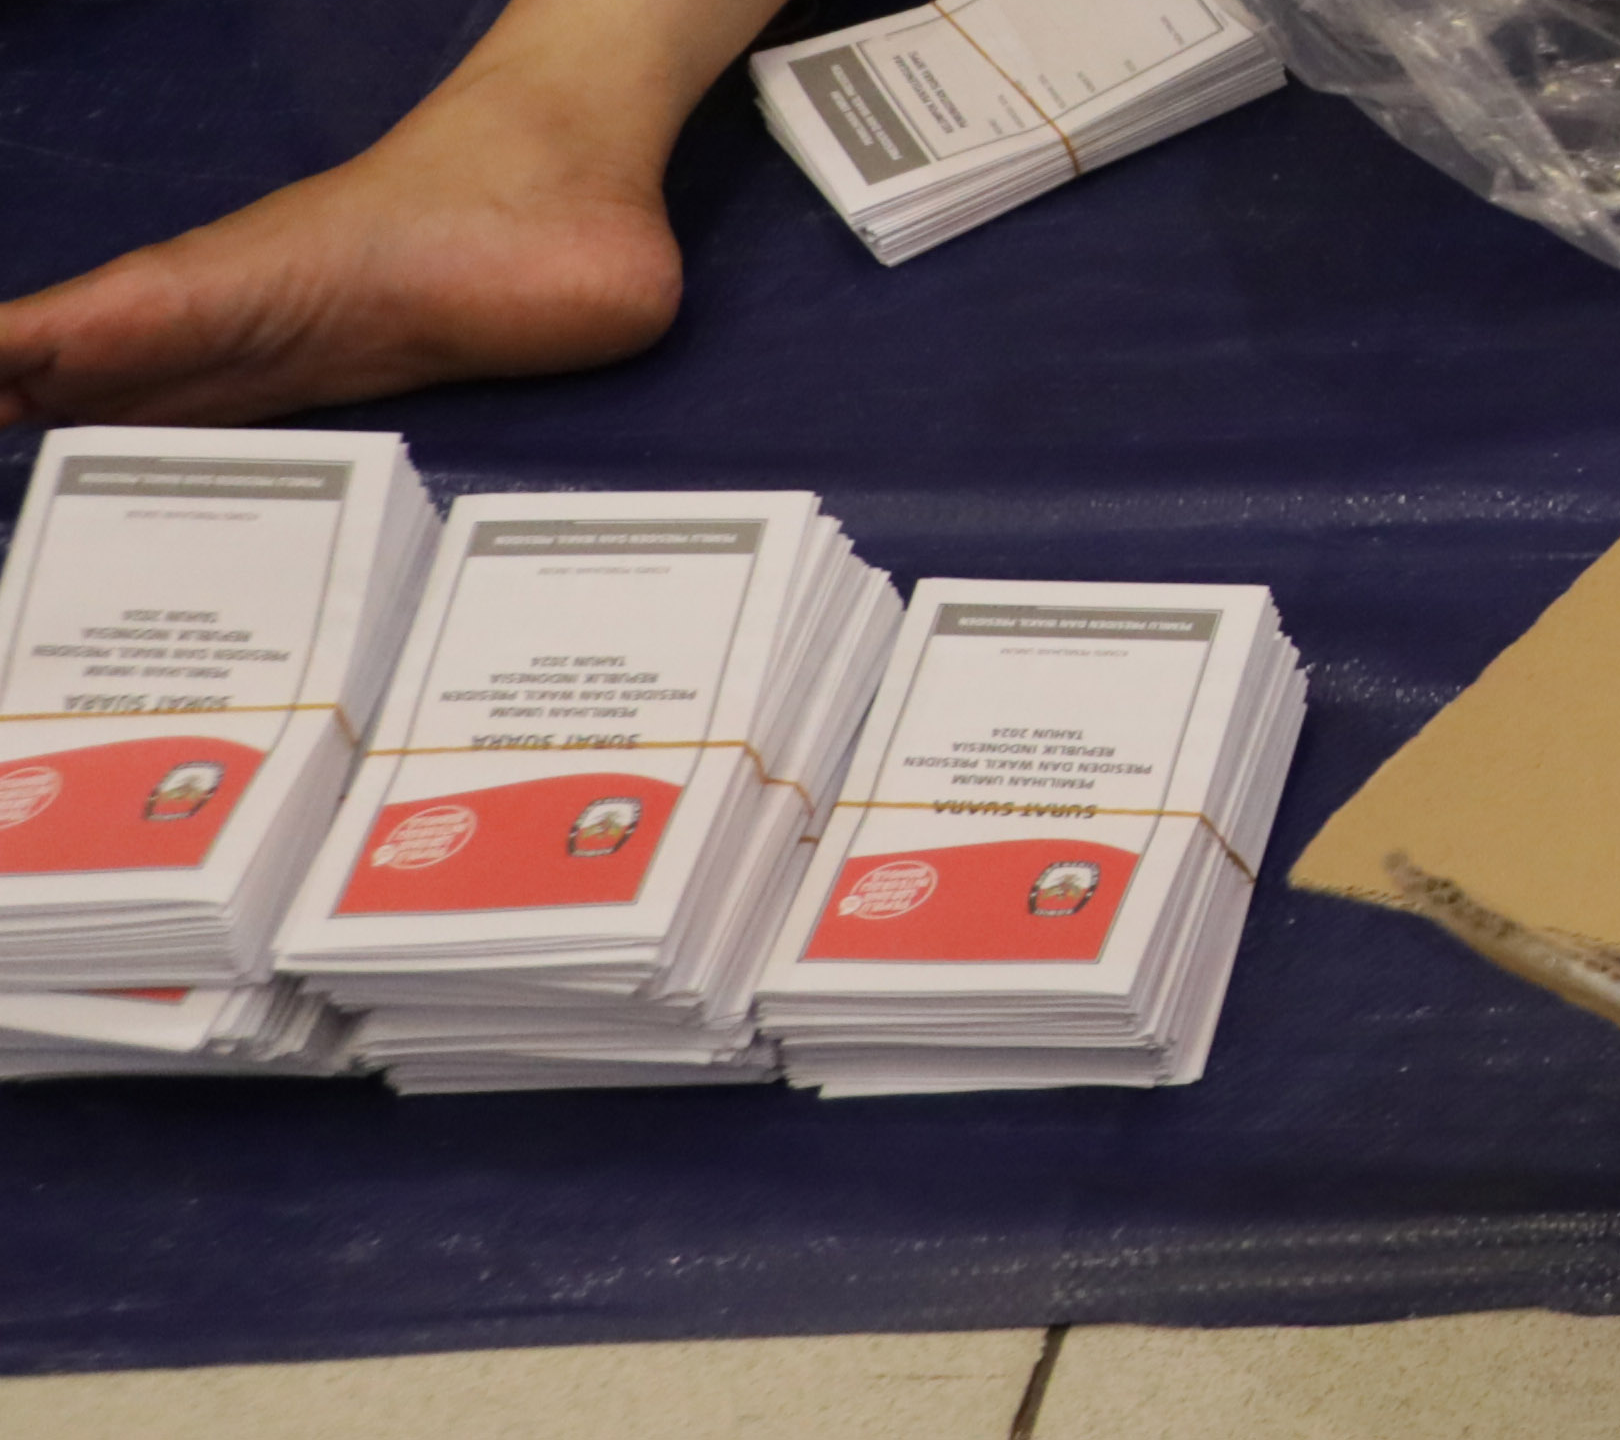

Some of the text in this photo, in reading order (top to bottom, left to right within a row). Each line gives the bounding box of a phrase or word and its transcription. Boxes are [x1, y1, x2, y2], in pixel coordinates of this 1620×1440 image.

[991, 728, 1083, 739] TAHUN 2024
[952, 743, 1116, 757] REPUBLIK INDONESIA
[902, 756, 1152, 774] PRESIDEN DAN WAKIL PRESIDEN
[951, 775, 1095, 789] PEMILIHAN UMUM
